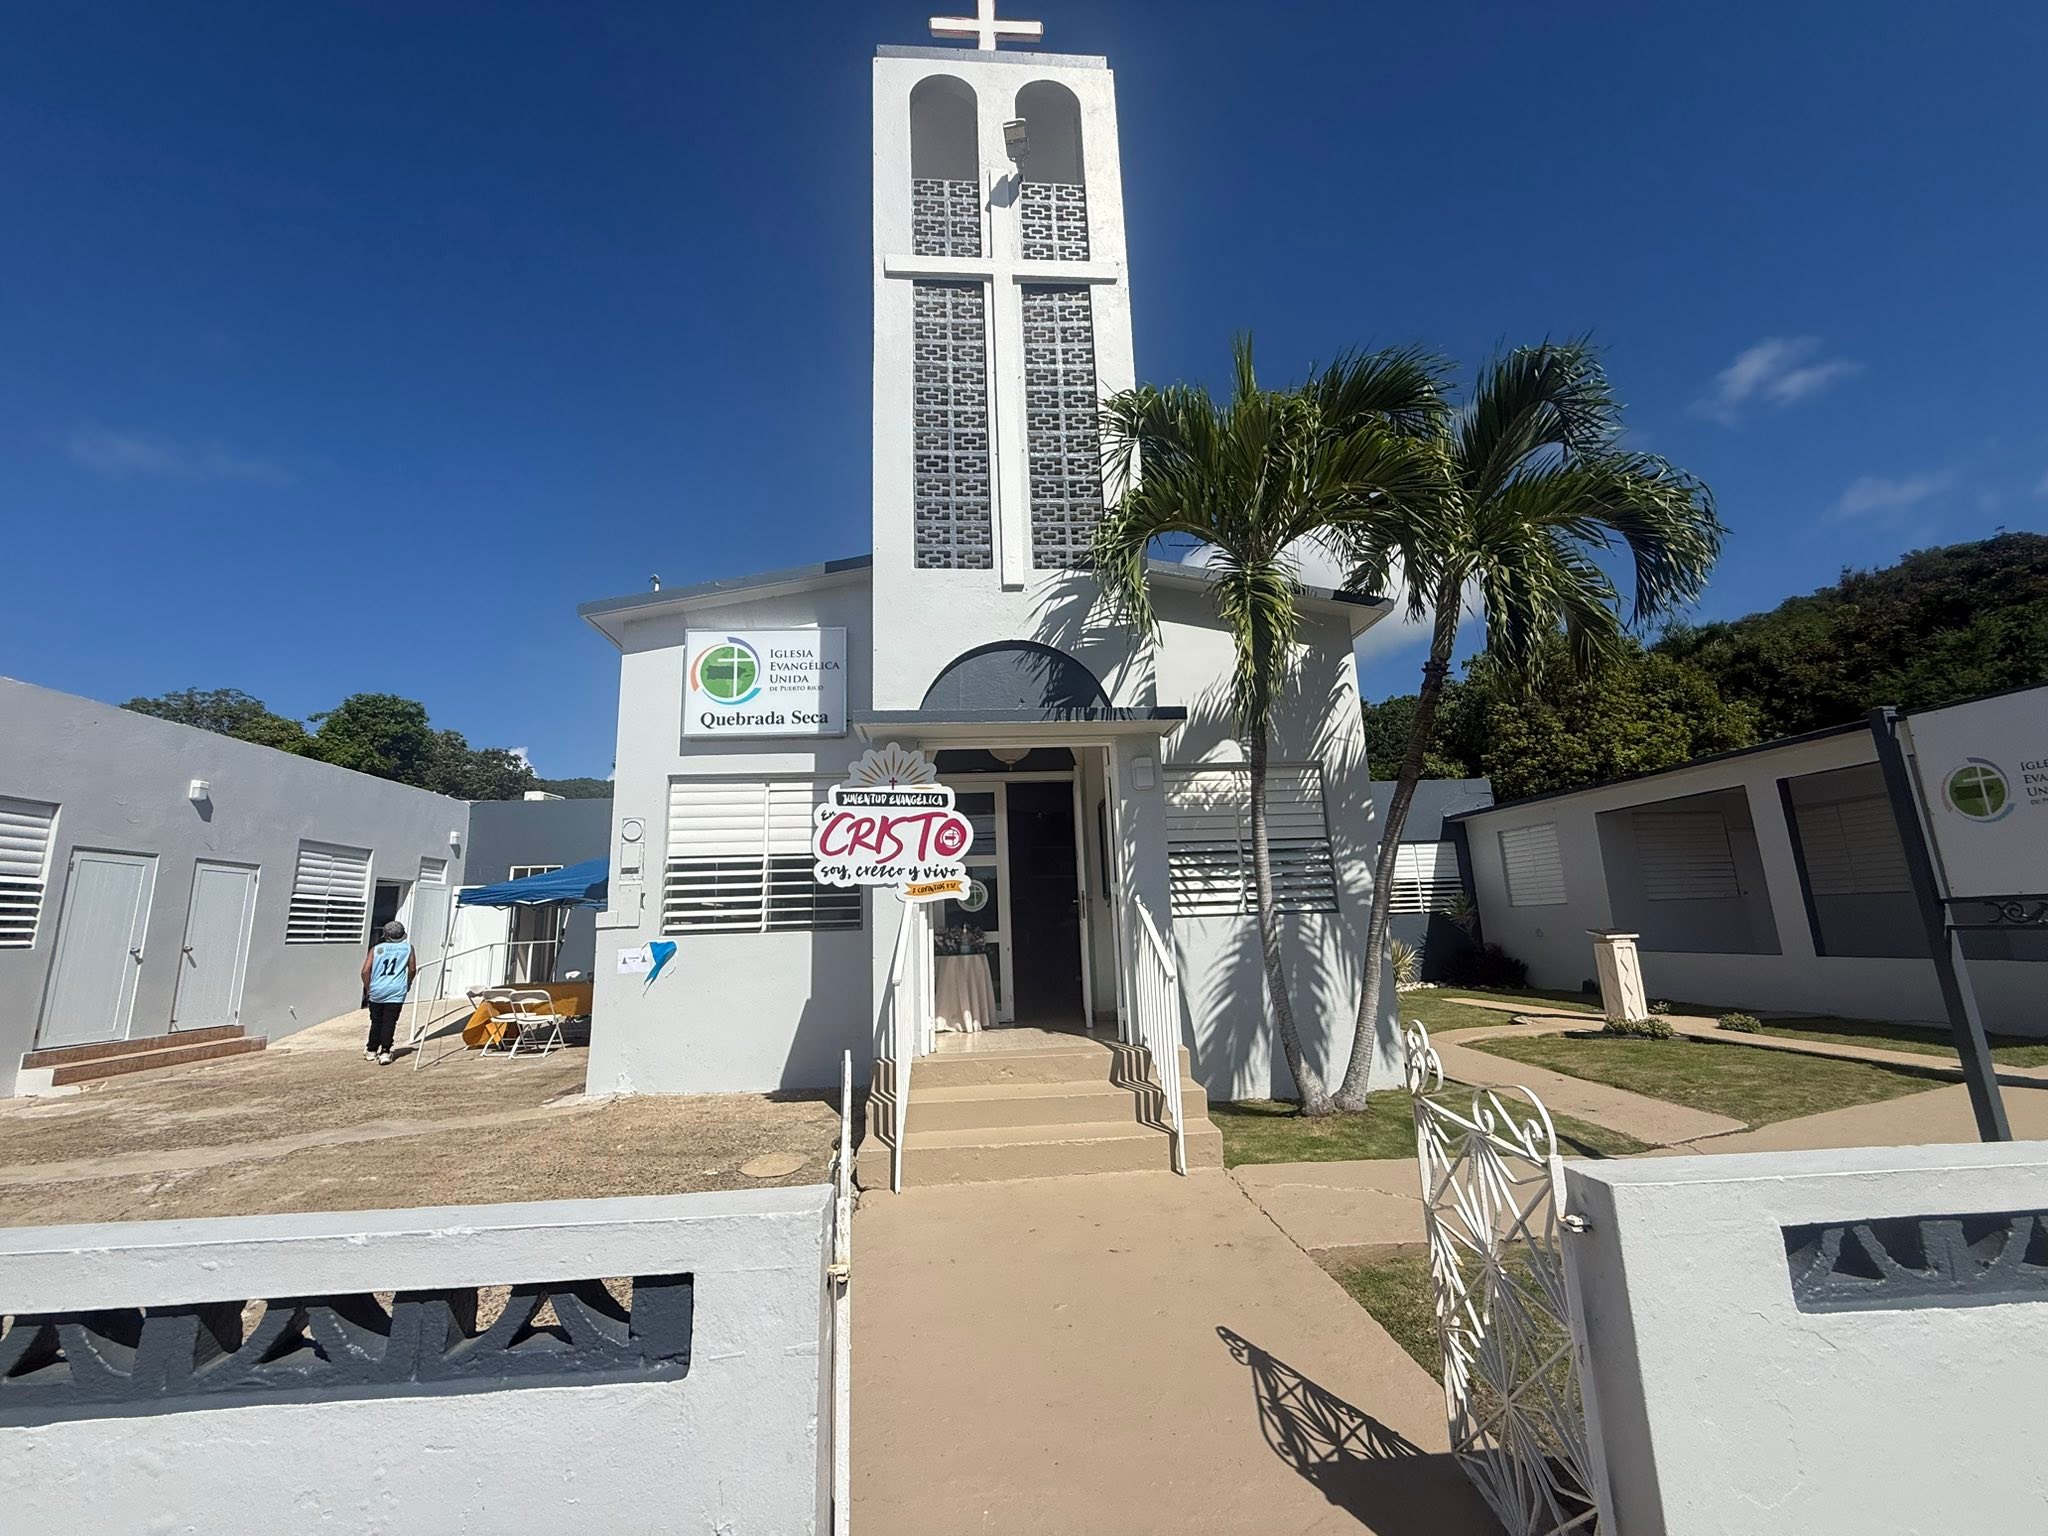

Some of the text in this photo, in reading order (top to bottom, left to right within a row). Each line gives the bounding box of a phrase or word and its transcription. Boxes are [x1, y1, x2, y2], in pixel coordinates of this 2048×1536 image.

[770, 649, 813, 658] IGLESIA
[770, 660, 840, 671] EVANGÉLICA
[769, 674, 809, 684] UNIDA
[700, 709, 829, 729] Quebrada Seca
[842, 793, 943, 806] JUVENTUD EVANGÉLICA
[820, 809, 837, 822] En
[819, 811, 967, 865] CRISTO
[820, 863, 960, 881] soy, crezco y vivo
[380, 958, 397, 977] 11
